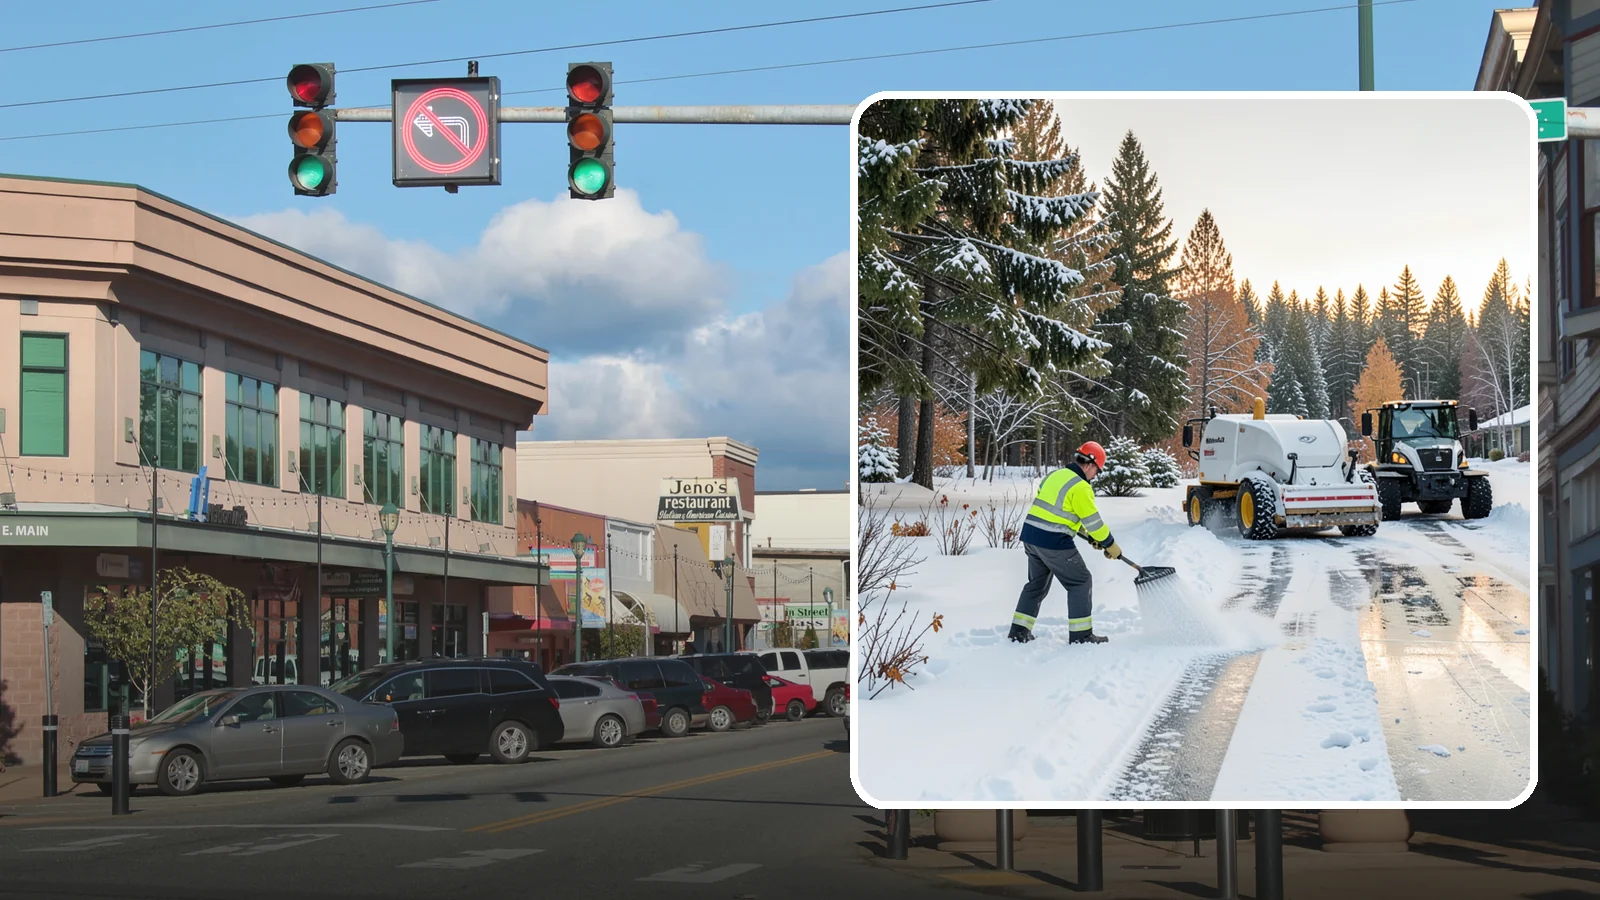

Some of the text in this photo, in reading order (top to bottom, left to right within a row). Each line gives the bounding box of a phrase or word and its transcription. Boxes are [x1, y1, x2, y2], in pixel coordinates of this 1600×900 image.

[669, 479, 728, 495] Jeno's
[665, 496, 731, 509] restaurant
[658, 509, 682, 520] Italian
[685, 509, 715, 519] American
[714, 509, 738, 519] Cuisine
[2, 525, 49, 536] E. MAIN
[797, 607, 829, 617] Street
[791, 619, 824, 627] lass
